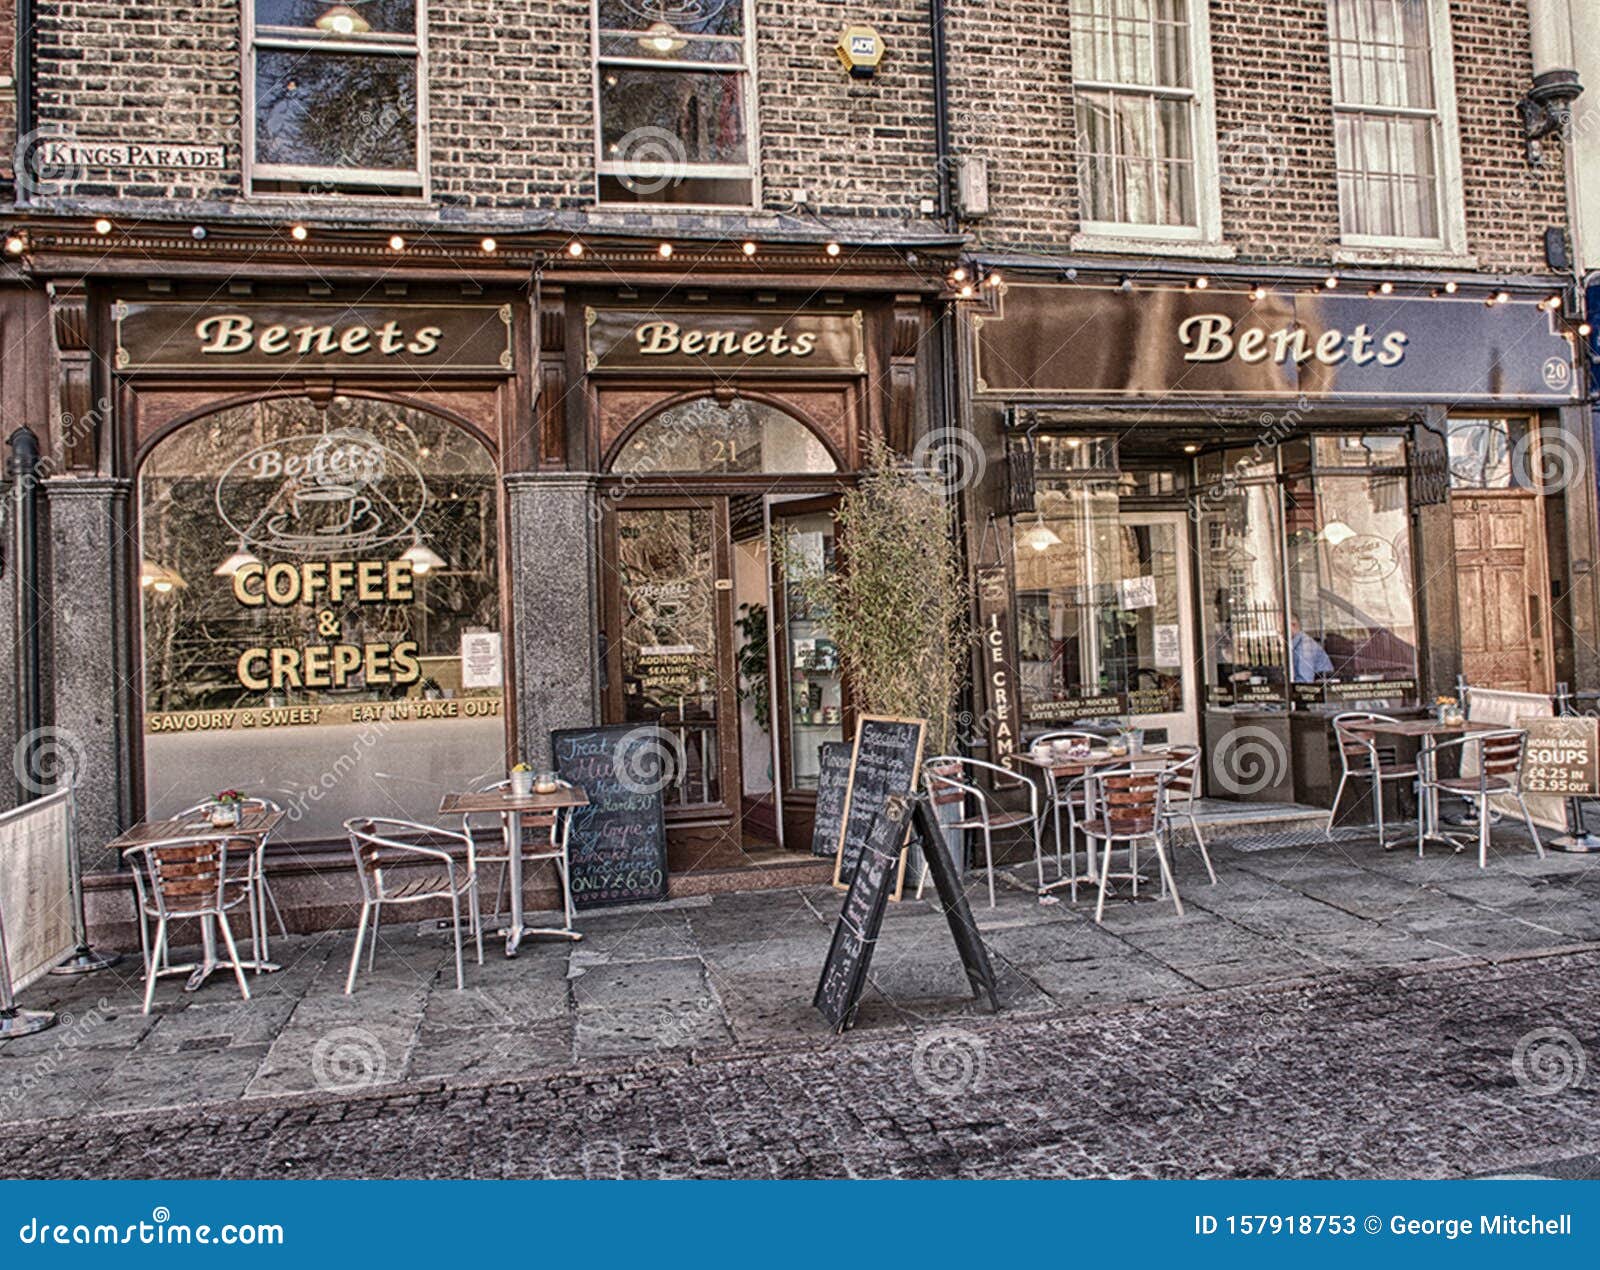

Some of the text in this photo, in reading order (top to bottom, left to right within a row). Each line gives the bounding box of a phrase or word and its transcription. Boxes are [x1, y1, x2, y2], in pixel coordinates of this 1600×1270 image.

[851, 36, 874, 55] ADT
[126, 146, 221, 168] PARADE
[195, 313, 444, 355] Benets
[635, 320, 817, 356] Benets
[1178, 313, 1409, 366] Benets
[1546, 364, 1567, 380] 20
[249, 446, 381, 479] Benets
[710, 440, 737, 463] 21
[232, 559, 414, 606] COFFEE
[318, 609, 341, 637] &
[988, 613, 1003, 663] ICE
[236, 641, 421, 691] CREPES
[151, 709, 321, 732] SAVOURY & SWEET
[352, 700, 500, 721] EAT IN TAKE OUT
[992, 671, 1014, 770] CREAMS
[1077, 706, 1121, 717] CHOCOLATE
[561, 732, 610, 761] Treat
[1527, 738, 1588, 749] HOME MADE
[1526, 749, 1589, 764] SOUPS
[1528, 767, 1585, 779] £4.25 IN
[1528, 779, 1591, 791] £3.95 OUT
[572, 874, 613, 893] ONLY
